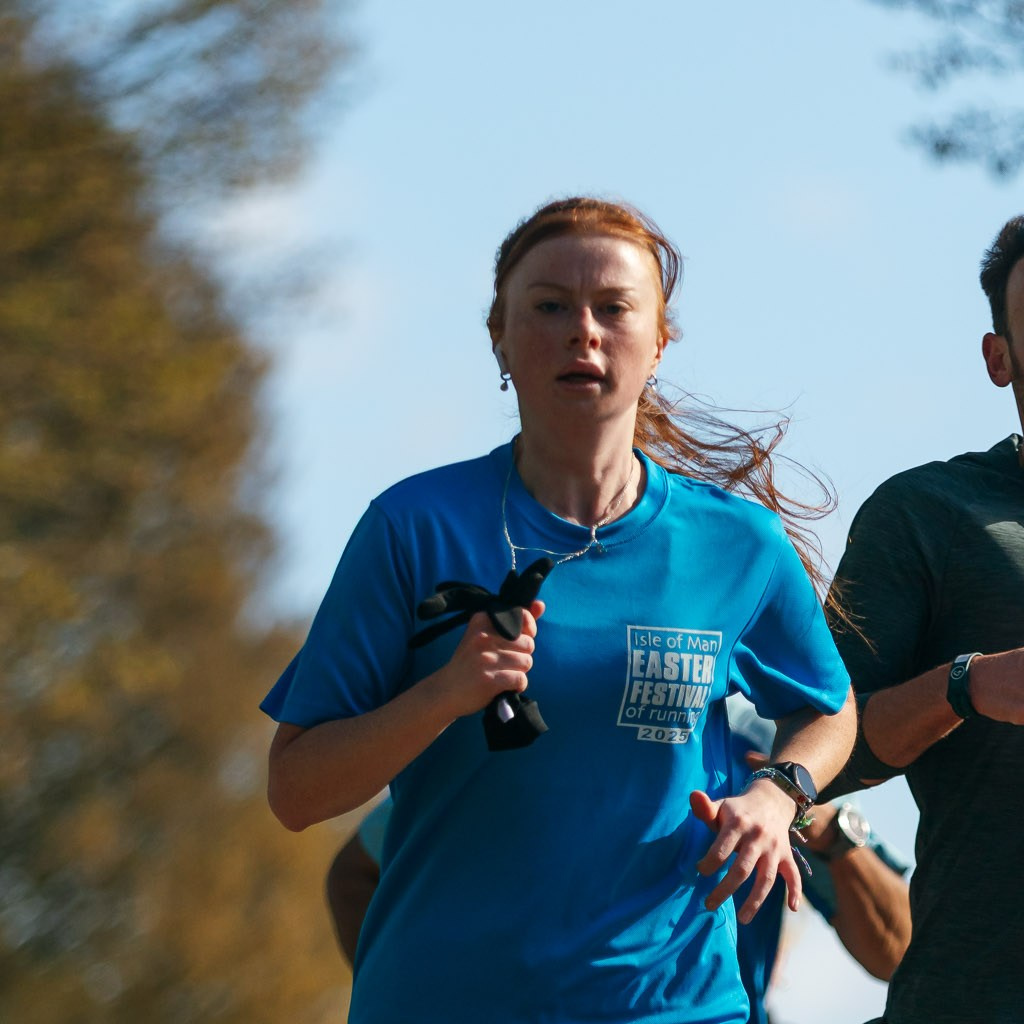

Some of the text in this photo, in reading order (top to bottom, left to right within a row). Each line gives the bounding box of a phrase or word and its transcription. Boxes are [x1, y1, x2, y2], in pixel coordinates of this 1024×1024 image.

[634, 631, 718, 652] Isle of Man
[631, 649, 714, 684] EASTER
[629, 680, 709, 709] FESTIVAL
[625, 705, 646, 719] of
[641, 728, 688, 742] 2025
